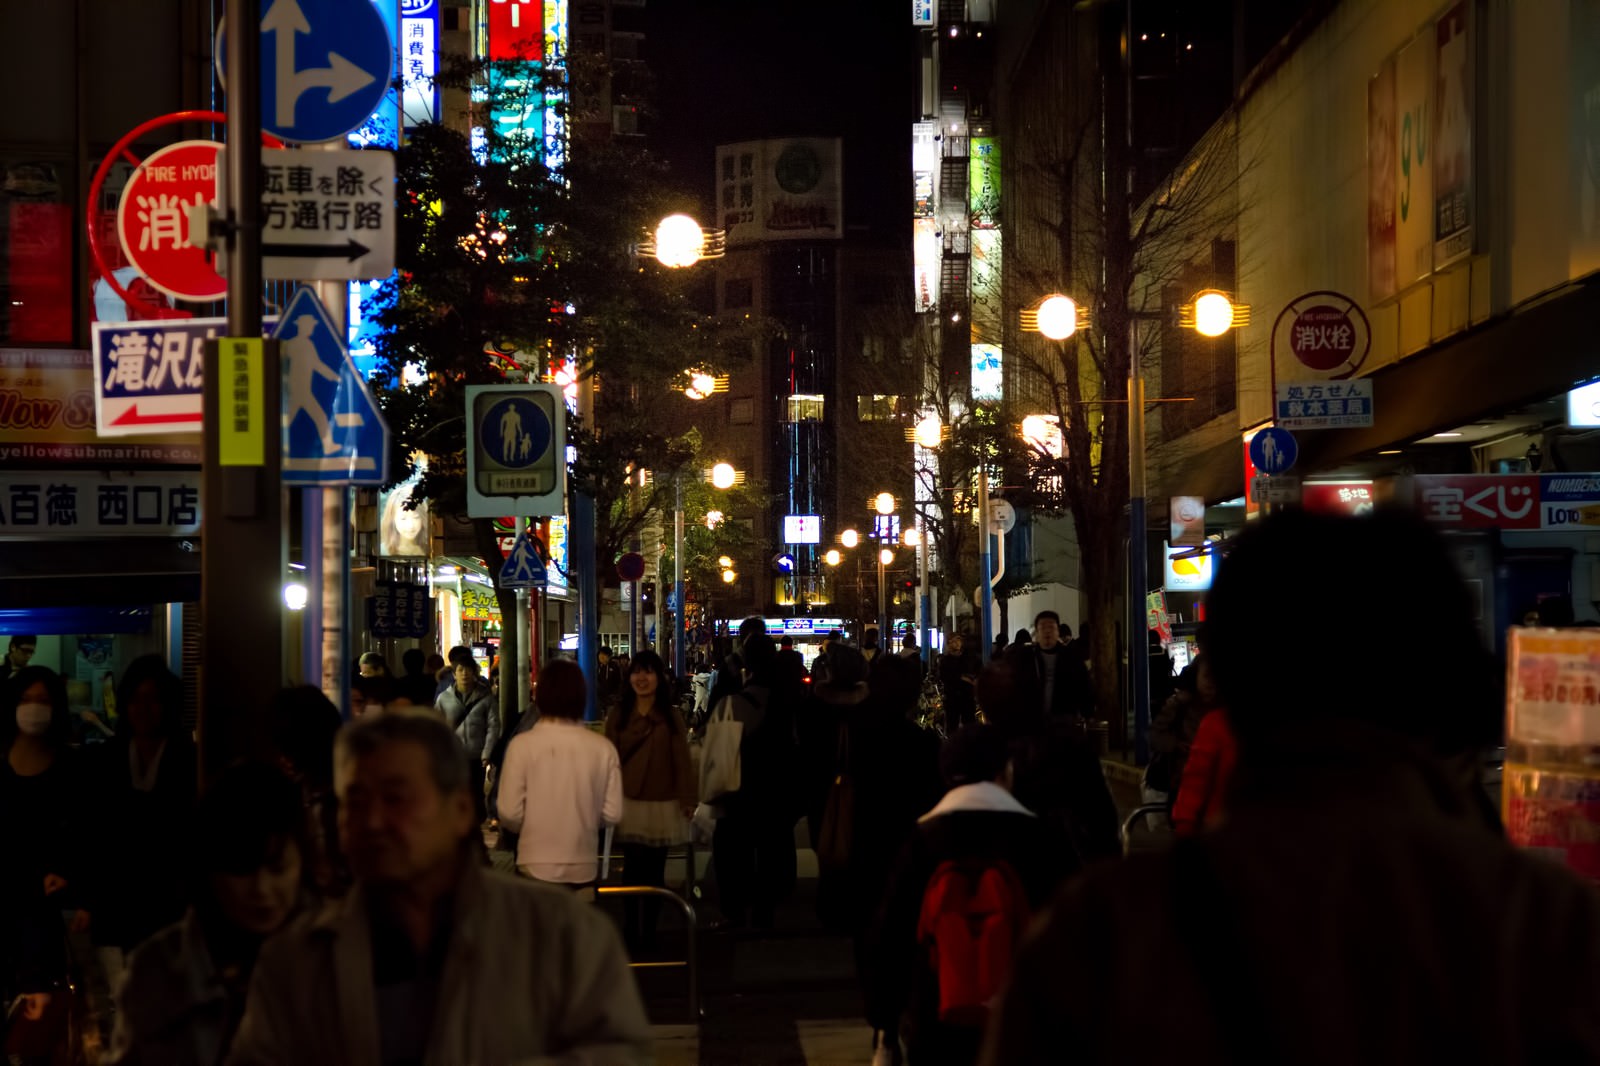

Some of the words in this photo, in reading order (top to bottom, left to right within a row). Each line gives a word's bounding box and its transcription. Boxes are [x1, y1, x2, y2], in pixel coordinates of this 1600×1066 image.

[145, 166, 177, 182] FIRE
[1295, 324, 1351, 351] 消火栓
[1288, 384, 1362, 400] 処方せん
[97, 484, 198, 525] 西口店
[1423, 484, 1533, 520] 宝くじ
[1548, 507, 1580, 525] LOTO
